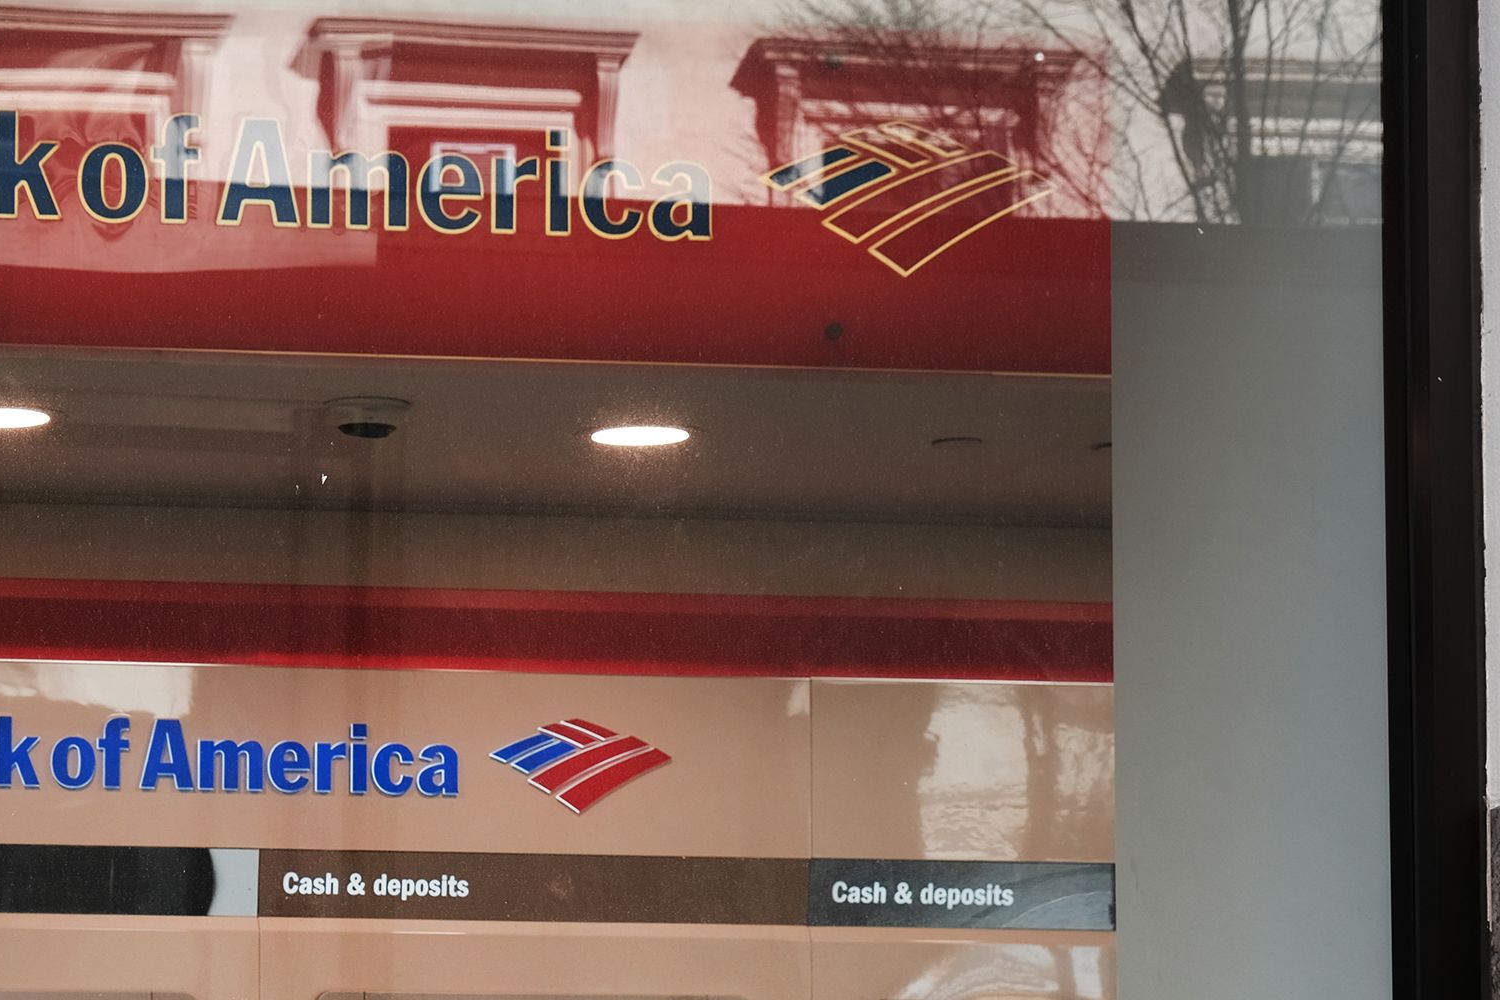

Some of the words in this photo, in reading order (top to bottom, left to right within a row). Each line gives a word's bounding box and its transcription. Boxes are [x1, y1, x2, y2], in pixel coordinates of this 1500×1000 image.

[77, 112, 203, 225] of
[216, 116, 713, 242] America
[50, 715, 131, 791] of
[138, 717, 460, 797] America
[282, 870, 340, 896] Cash
[347, 873, 366, 897] &
[373, 873, 470, 901] deposits
[831, 880, 887, 904] Cash
[894, 882, 913, 905] &
[920, 883, 1014, 909] deposits
